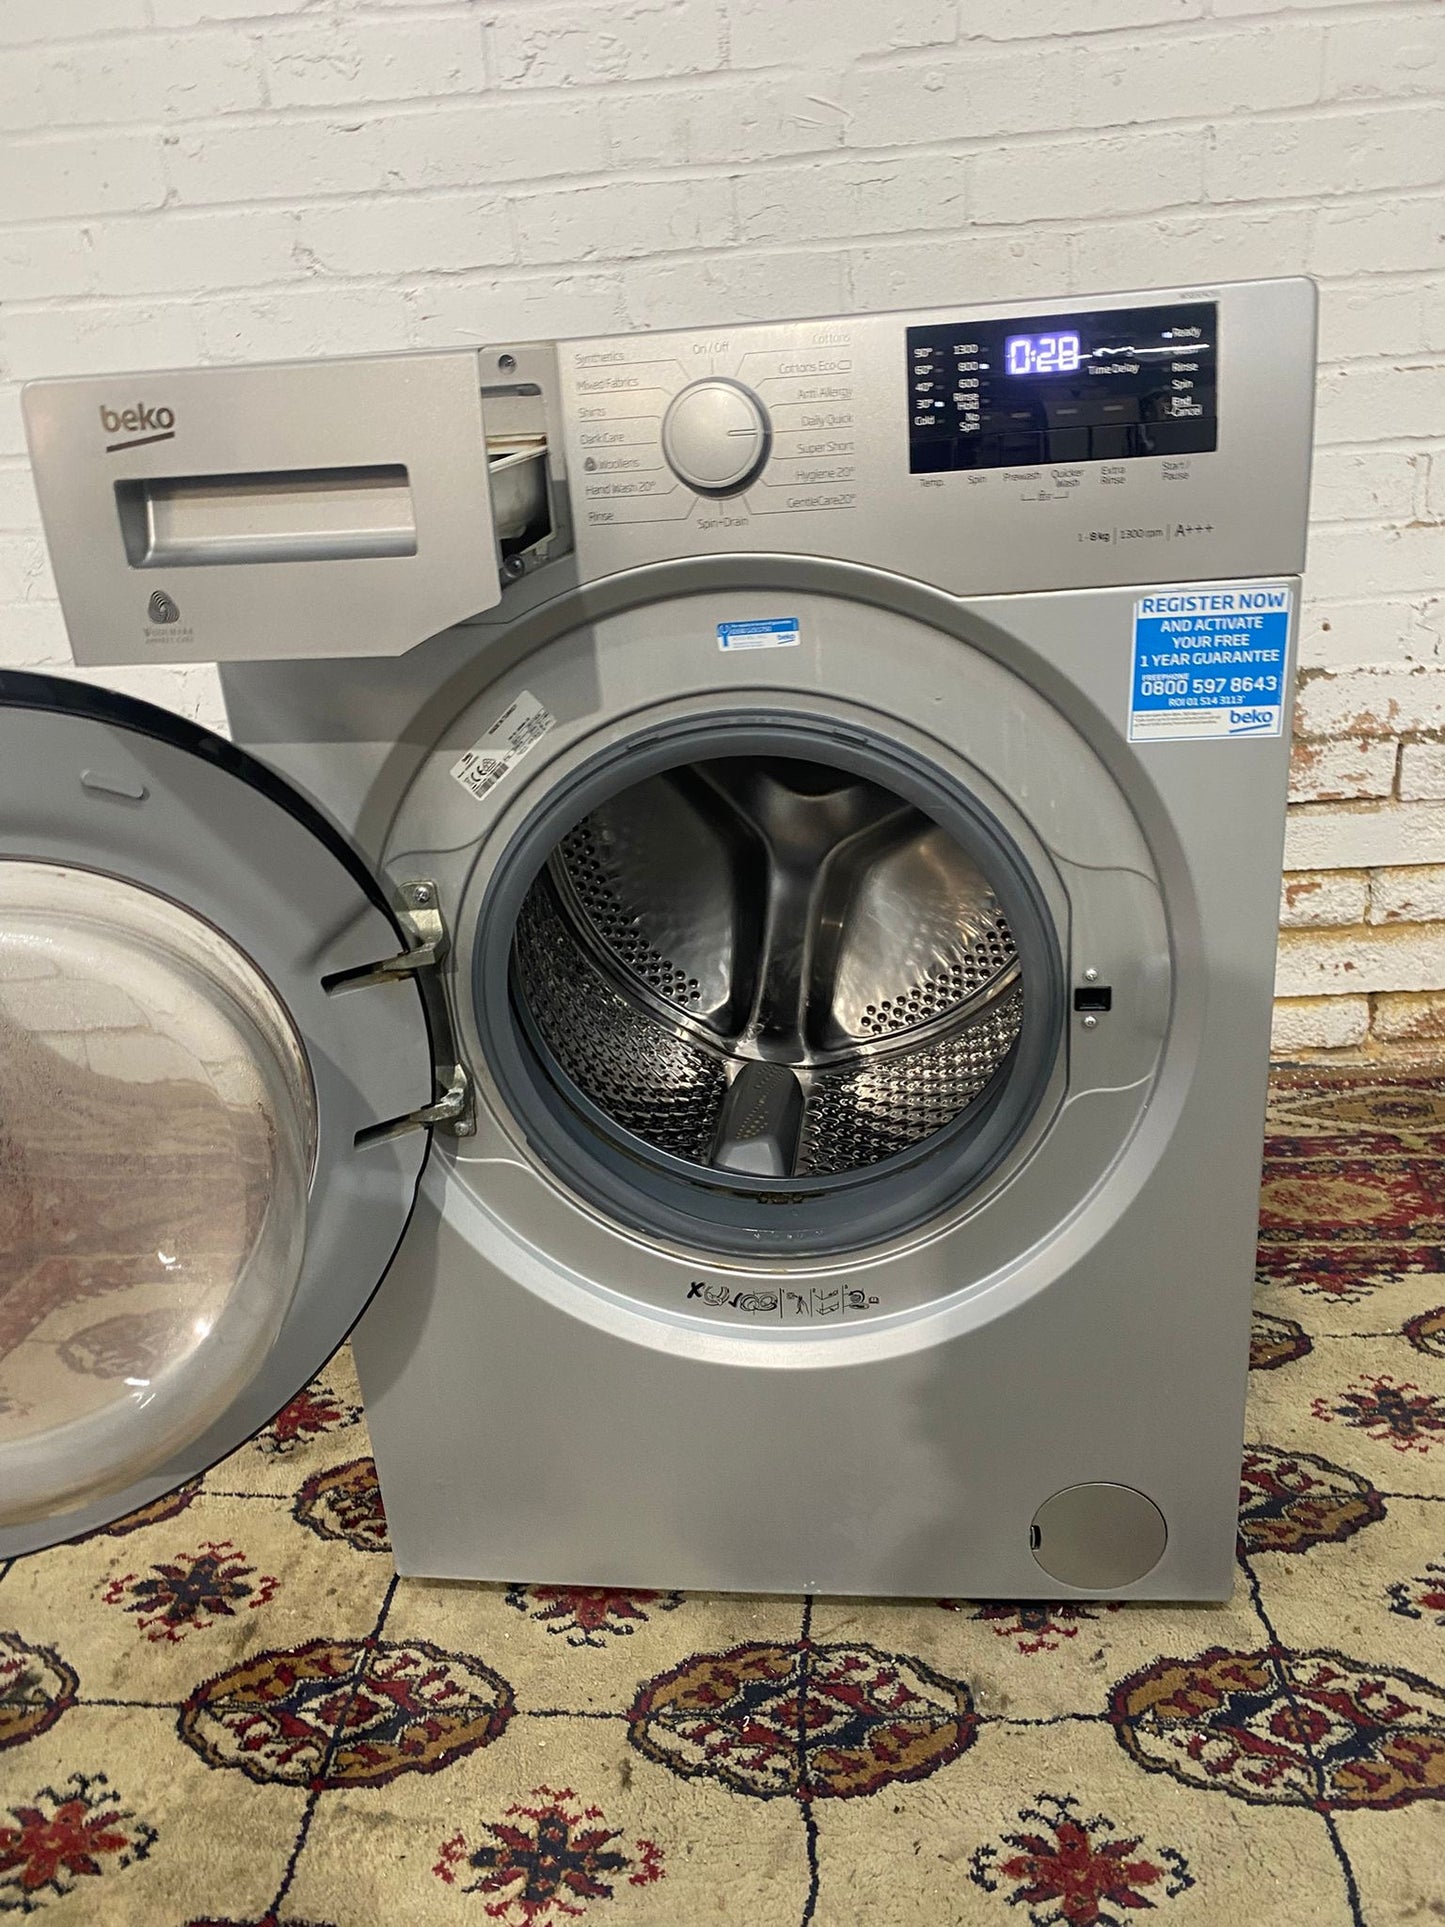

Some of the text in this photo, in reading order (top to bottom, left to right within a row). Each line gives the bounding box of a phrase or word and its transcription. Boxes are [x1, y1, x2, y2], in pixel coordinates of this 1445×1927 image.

[812, 333, 851, 345] Cottons
[1172, 326, 1202, 339] Ready
[953, 343, 979, 355] 1300
[574, 352, 625, 365] Synthetics
[778, 360, 835, 374] Cottons Eco
[1112, 362, 1140, 375] Delay
[1171, 362, 1199, 373] Rinse
[576, 376, 640, 391] Mixed Fabrics
[1171, 378, 1194, 391] Spin
[798, 387, 853, 400] Anti Allergy
[100, 402, 175, 433] beko
[578, 407, 607, 419] Shirts
[801, 413, 853, 428] Daily Quick
[913, 415, 936, 426] Cold
[959, 421, 981, 433] Spin
[796, 440, 855, 455] Super Short
[599, 457, 640, 469] Woollens
[796, 467, 836, 481] Hygiene
[1002, 472, 1042, 482] Prewash
[1050, 469, 1085, 479] Quicker
[1101, 466, 1126, 475] Extra
[1161, 472, 1190, 481] Pause
[967, 475, 987, 485] Spin
[1101, 476, 1126, 485] Rinse
[585, 485, 611, 496] Hand
[611, 483, 638, 495] Wash
[588, 511, 615, 522] Rinse
[1142, 592, 1285, 613] REGISTER NOW
[1160, 616, 1264, 632] AND ACTIVATE
[1172, 634, 1250, 649] YOUR FREE
[1140, 649, 1281, 667] 1 YEAR GUARANTEE
[1141, 676, 1278, 696] 0800 597 8643
[1229, 709, 1273, 724] beko
